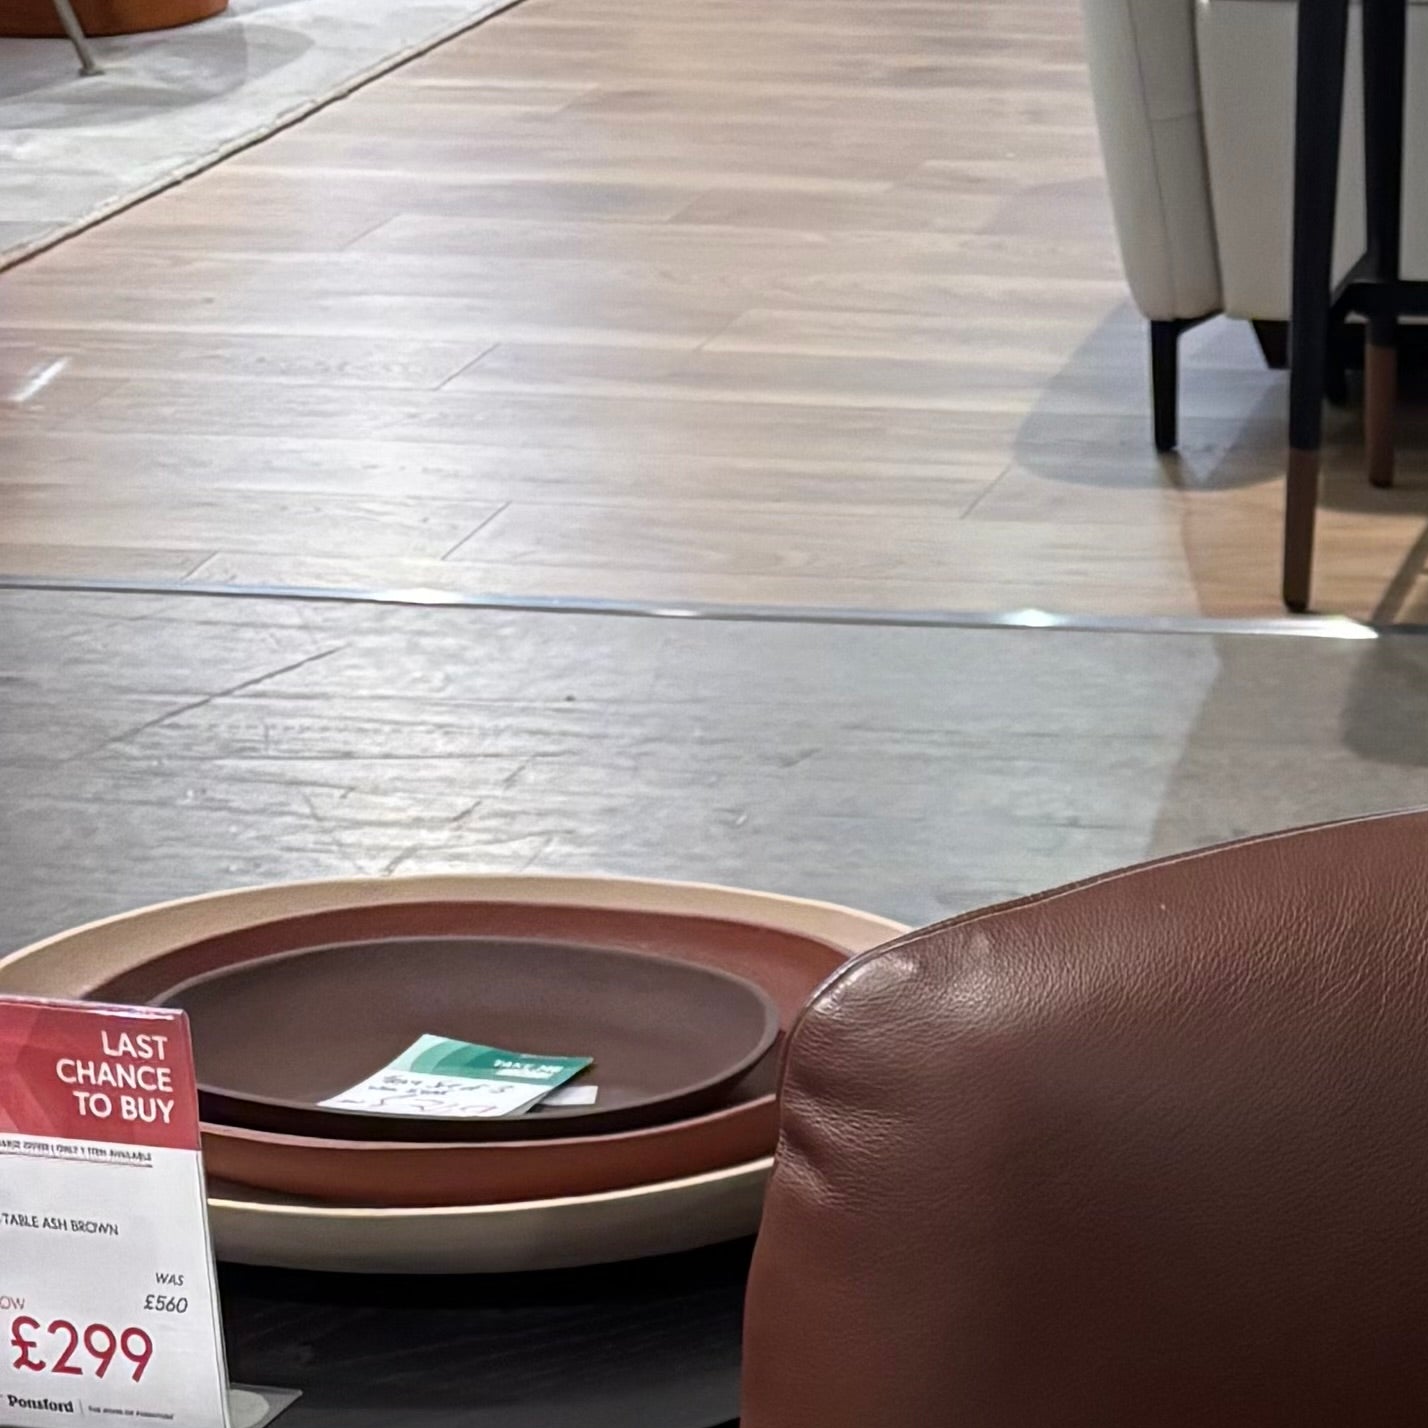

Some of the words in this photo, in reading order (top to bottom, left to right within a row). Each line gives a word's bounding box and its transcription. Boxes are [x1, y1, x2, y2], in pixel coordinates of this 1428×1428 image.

[101, 1030, 168, 1060] LAST
[56, 1058, 173, 1093] CHANCE
[72, 1090, 112, 1118] TO
[120, 1095, 174, 1124] BUY
[2, 1212, 39, 1228] TABLE
[42, 1216, 68, 1231] ASH
[70, 1219, 119, 1236] BROWN
[155, 1272, 184, 1287] WAS
[0, 1295, 25, 1310] OW
[143, 1293, 188, 1314] £560
[11, 1315, 153, 1383] £299
[7, 1394, 74, 1414] Ponsford
